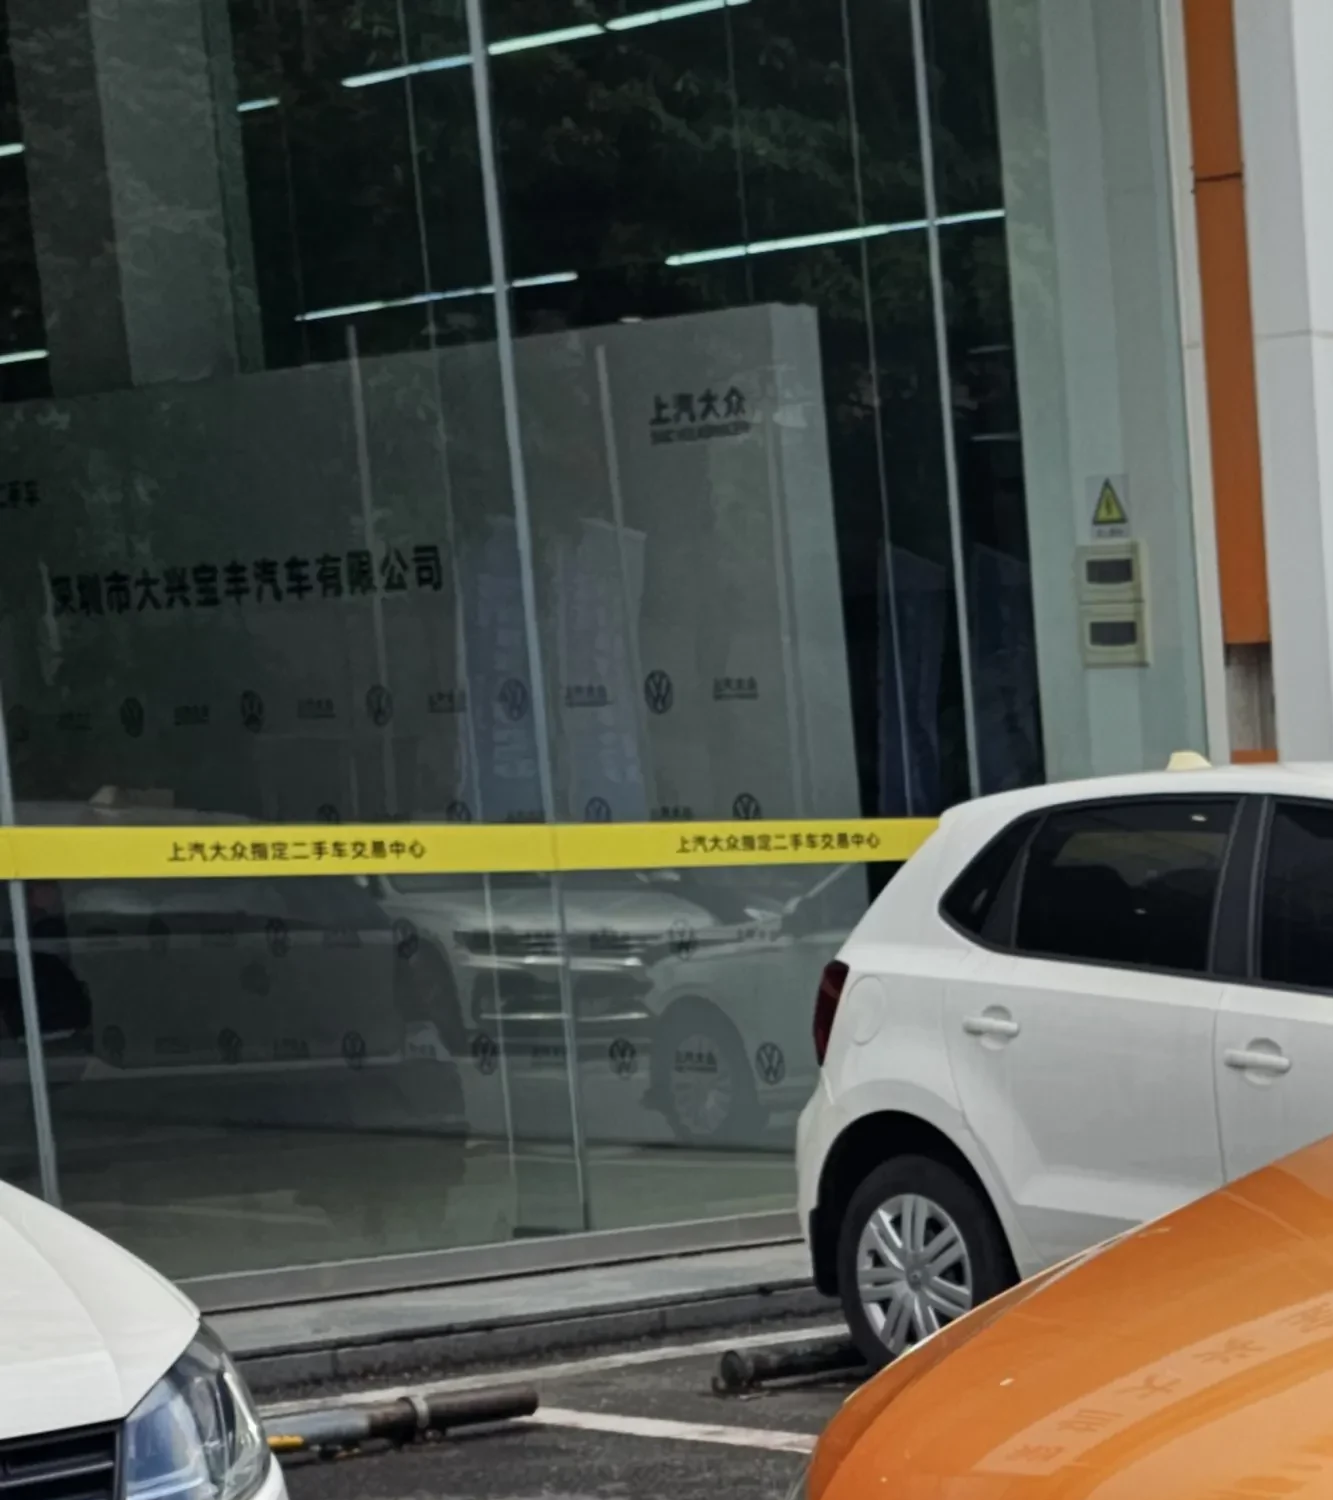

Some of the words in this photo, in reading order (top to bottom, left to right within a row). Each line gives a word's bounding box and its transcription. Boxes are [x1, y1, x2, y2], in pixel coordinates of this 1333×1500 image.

[648, 384, 746, 426] 上汽大众
[167, 837, 428, 863] 上汽大众指定二手车交易中心
[675, 831, 882, 855] 上汽大众指定二手车交易中心
